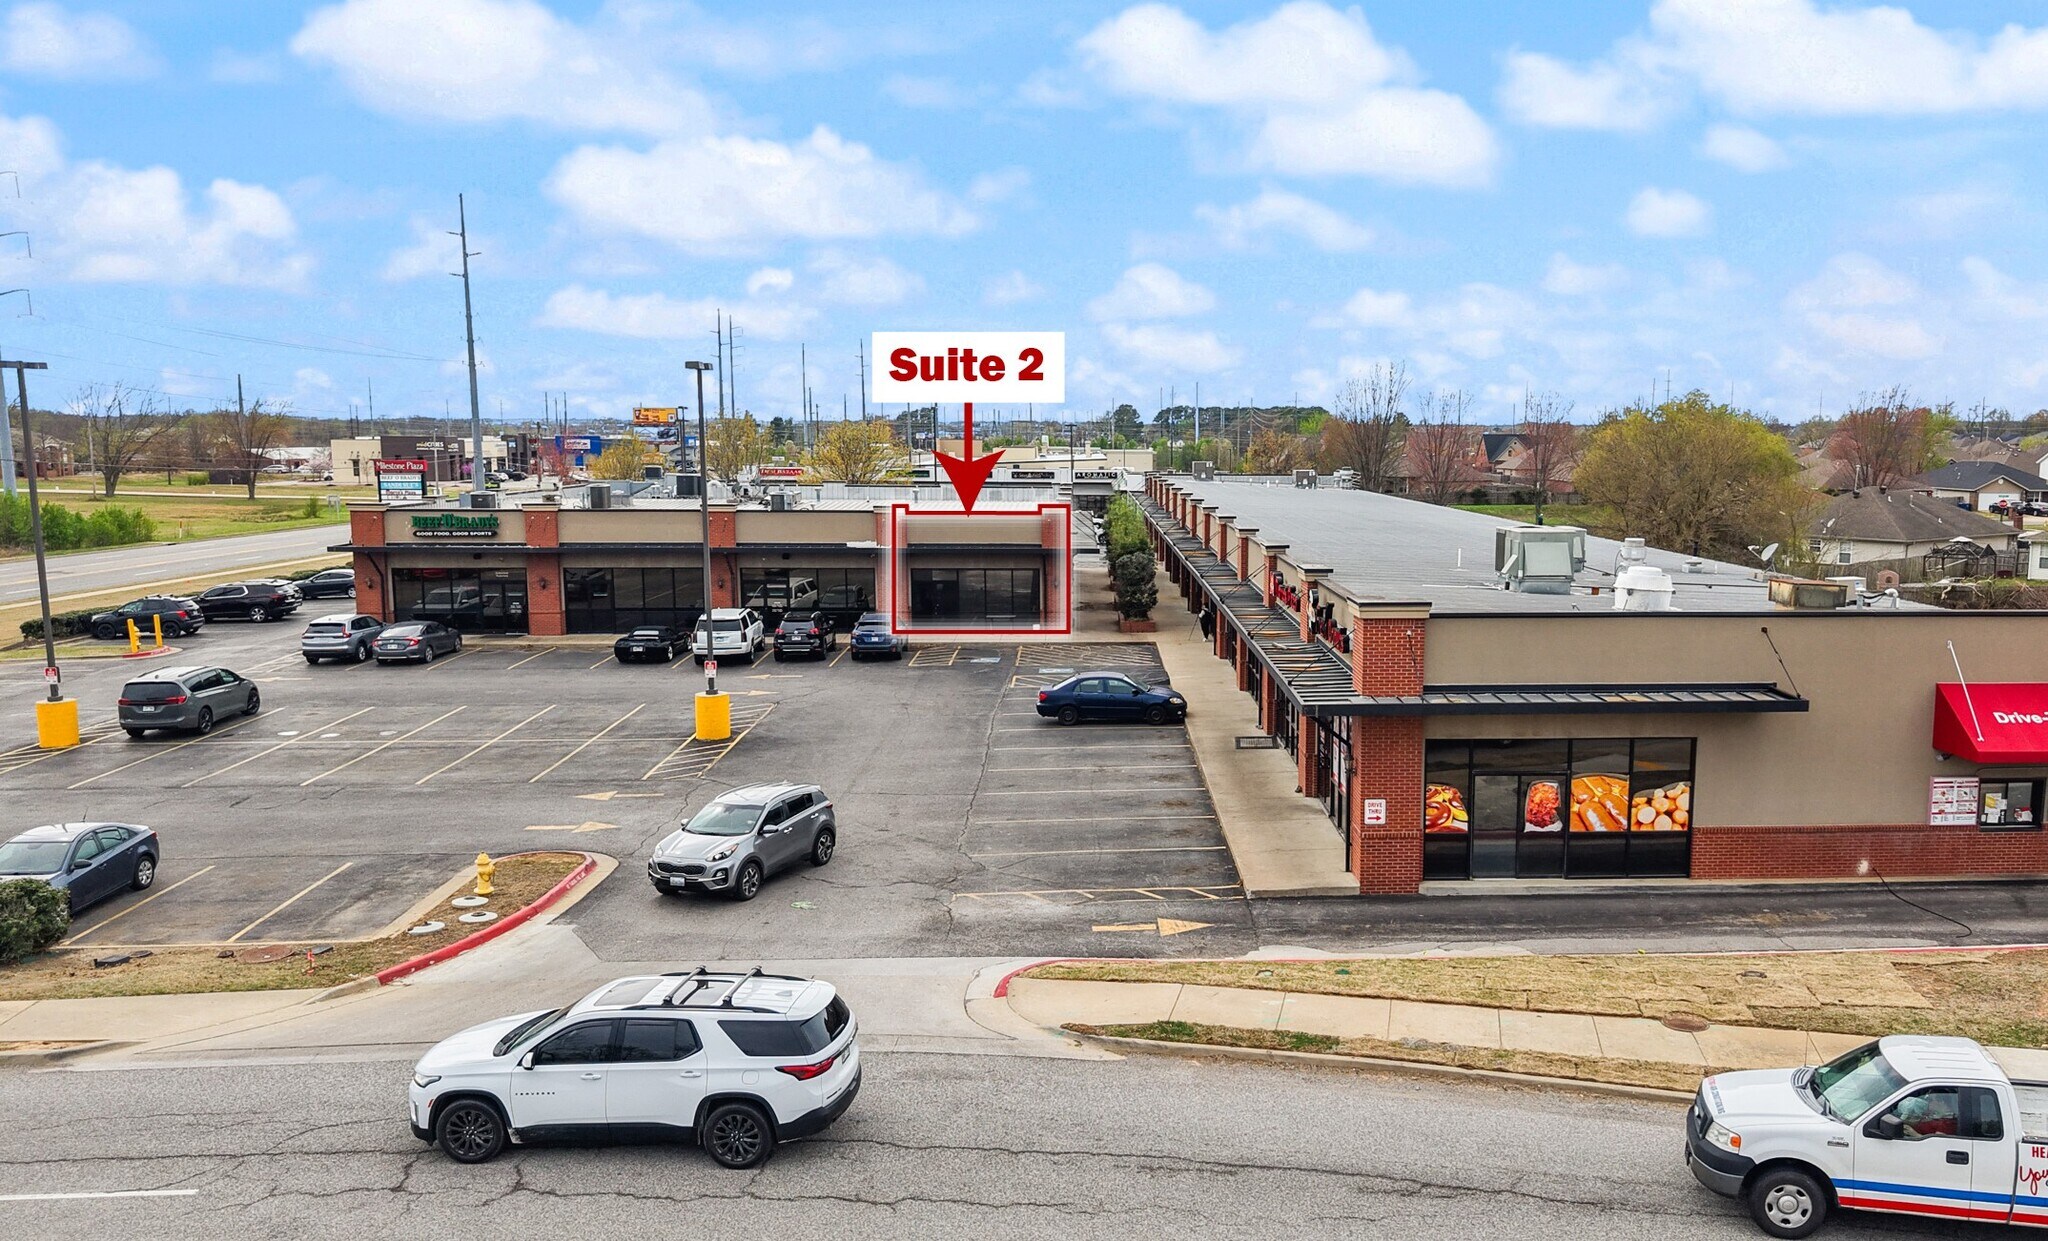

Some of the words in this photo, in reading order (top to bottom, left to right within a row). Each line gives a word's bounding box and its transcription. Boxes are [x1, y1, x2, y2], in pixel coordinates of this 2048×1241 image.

[376, 461, 405, 470] Milestone
[406, 461, 424, 470] Plaza
[2031, 1146, 2048, 1158] HE
